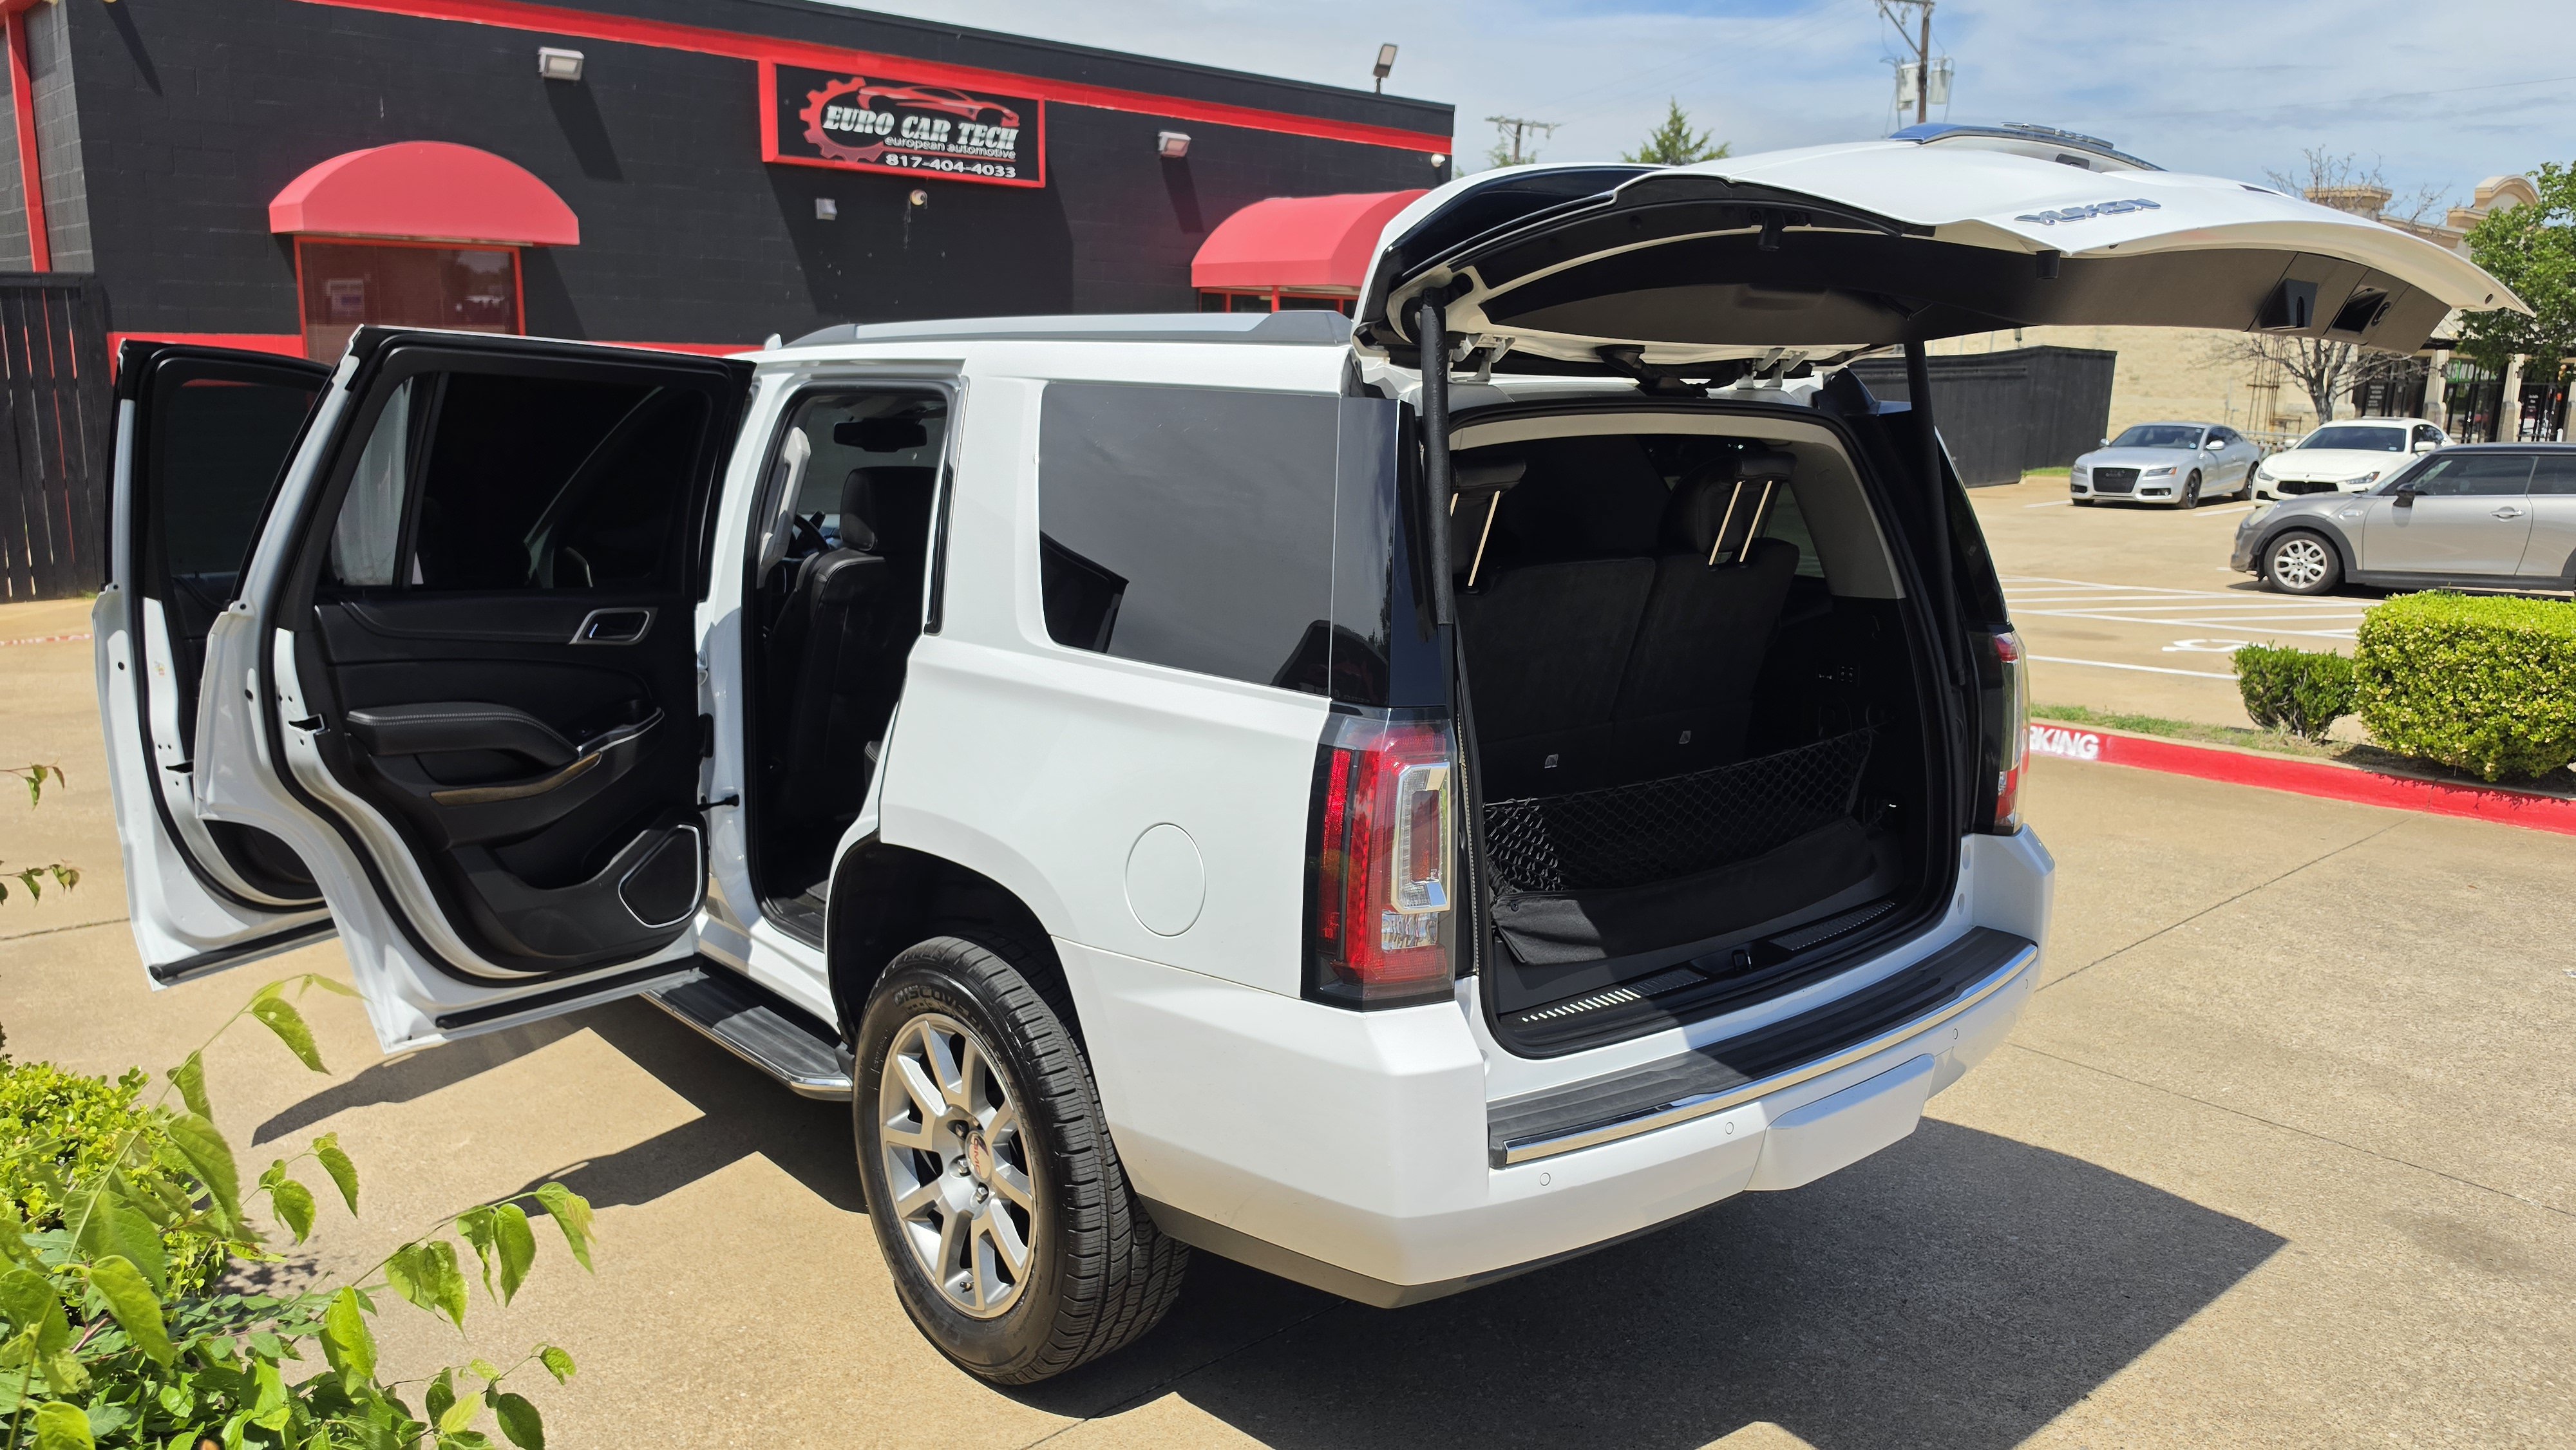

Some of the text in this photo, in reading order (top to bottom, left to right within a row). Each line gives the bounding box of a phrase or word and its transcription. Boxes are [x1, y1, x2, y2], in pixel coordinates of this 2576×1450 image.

[822, 106, 1019, 150] EURO CAR TECH
[884, 137, 1016, 160] european automotive
[886, 153, 1016, 178] 817-404-4033
